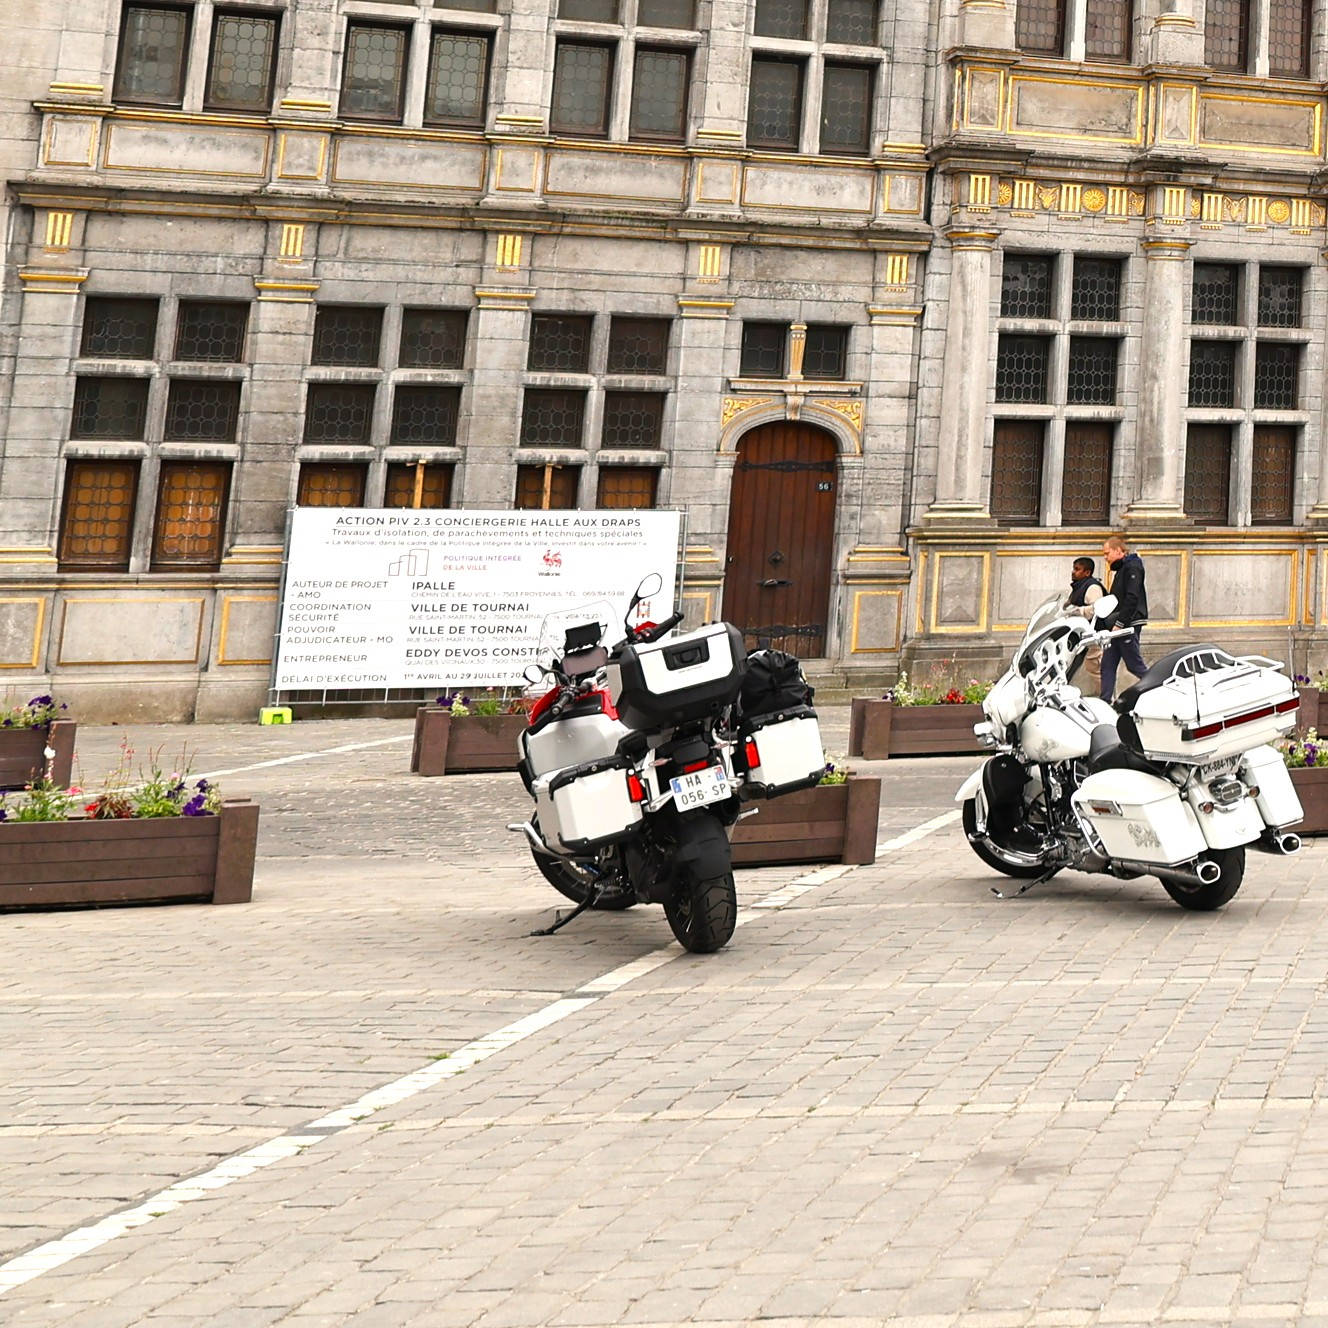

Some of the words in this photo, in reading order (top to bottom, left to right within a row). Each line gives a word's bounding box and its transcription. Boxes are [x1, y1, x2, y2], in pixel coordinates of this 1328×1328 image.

[818, 482, 829, 490] 56
[336, 516, 385, 525] ACTION
[389, 517, 410, 526] PIV
[413, 517, 431, 526] 2.3
[435, 518, 527, 527] CONCIERGERIE
[530, 518, 569, 527] HALLE
[573, 518, 598, 527] AUX
[601, 518, 641, 527] DRAPS
[332, 528, 371, 536] Travaux
[374, 529, 430, 537] d'isolation,
[432, 529, 446, 537] de
[532, 530, 542, 538] et
[544, 530, 598, 539] techniques
[600, 530, 643, 539] spéciales
[292, 580, 333, 588] AUTEUR
[335, 580, 349, 588] DE
[351, 580, 389, 588] PROJET
[412, 581, 456, 590] IPALLE
[289, 603, 372, 611] COORDINATION
[411, 603, 447, 612] VILLE
[451, 603, 468, 612] DE
[472, 603, 529, 612] TOURNAI
[288, 613, 340, 621] SÉCURITÉ
[409, 625, 445, 634] VILLE
[449, 625, 466, 634] DE
[470, 625, 528, 634] TOURNAI
[406, 648, 441, 657] EDDY
[445, 648, 488, 657] DEVOS
